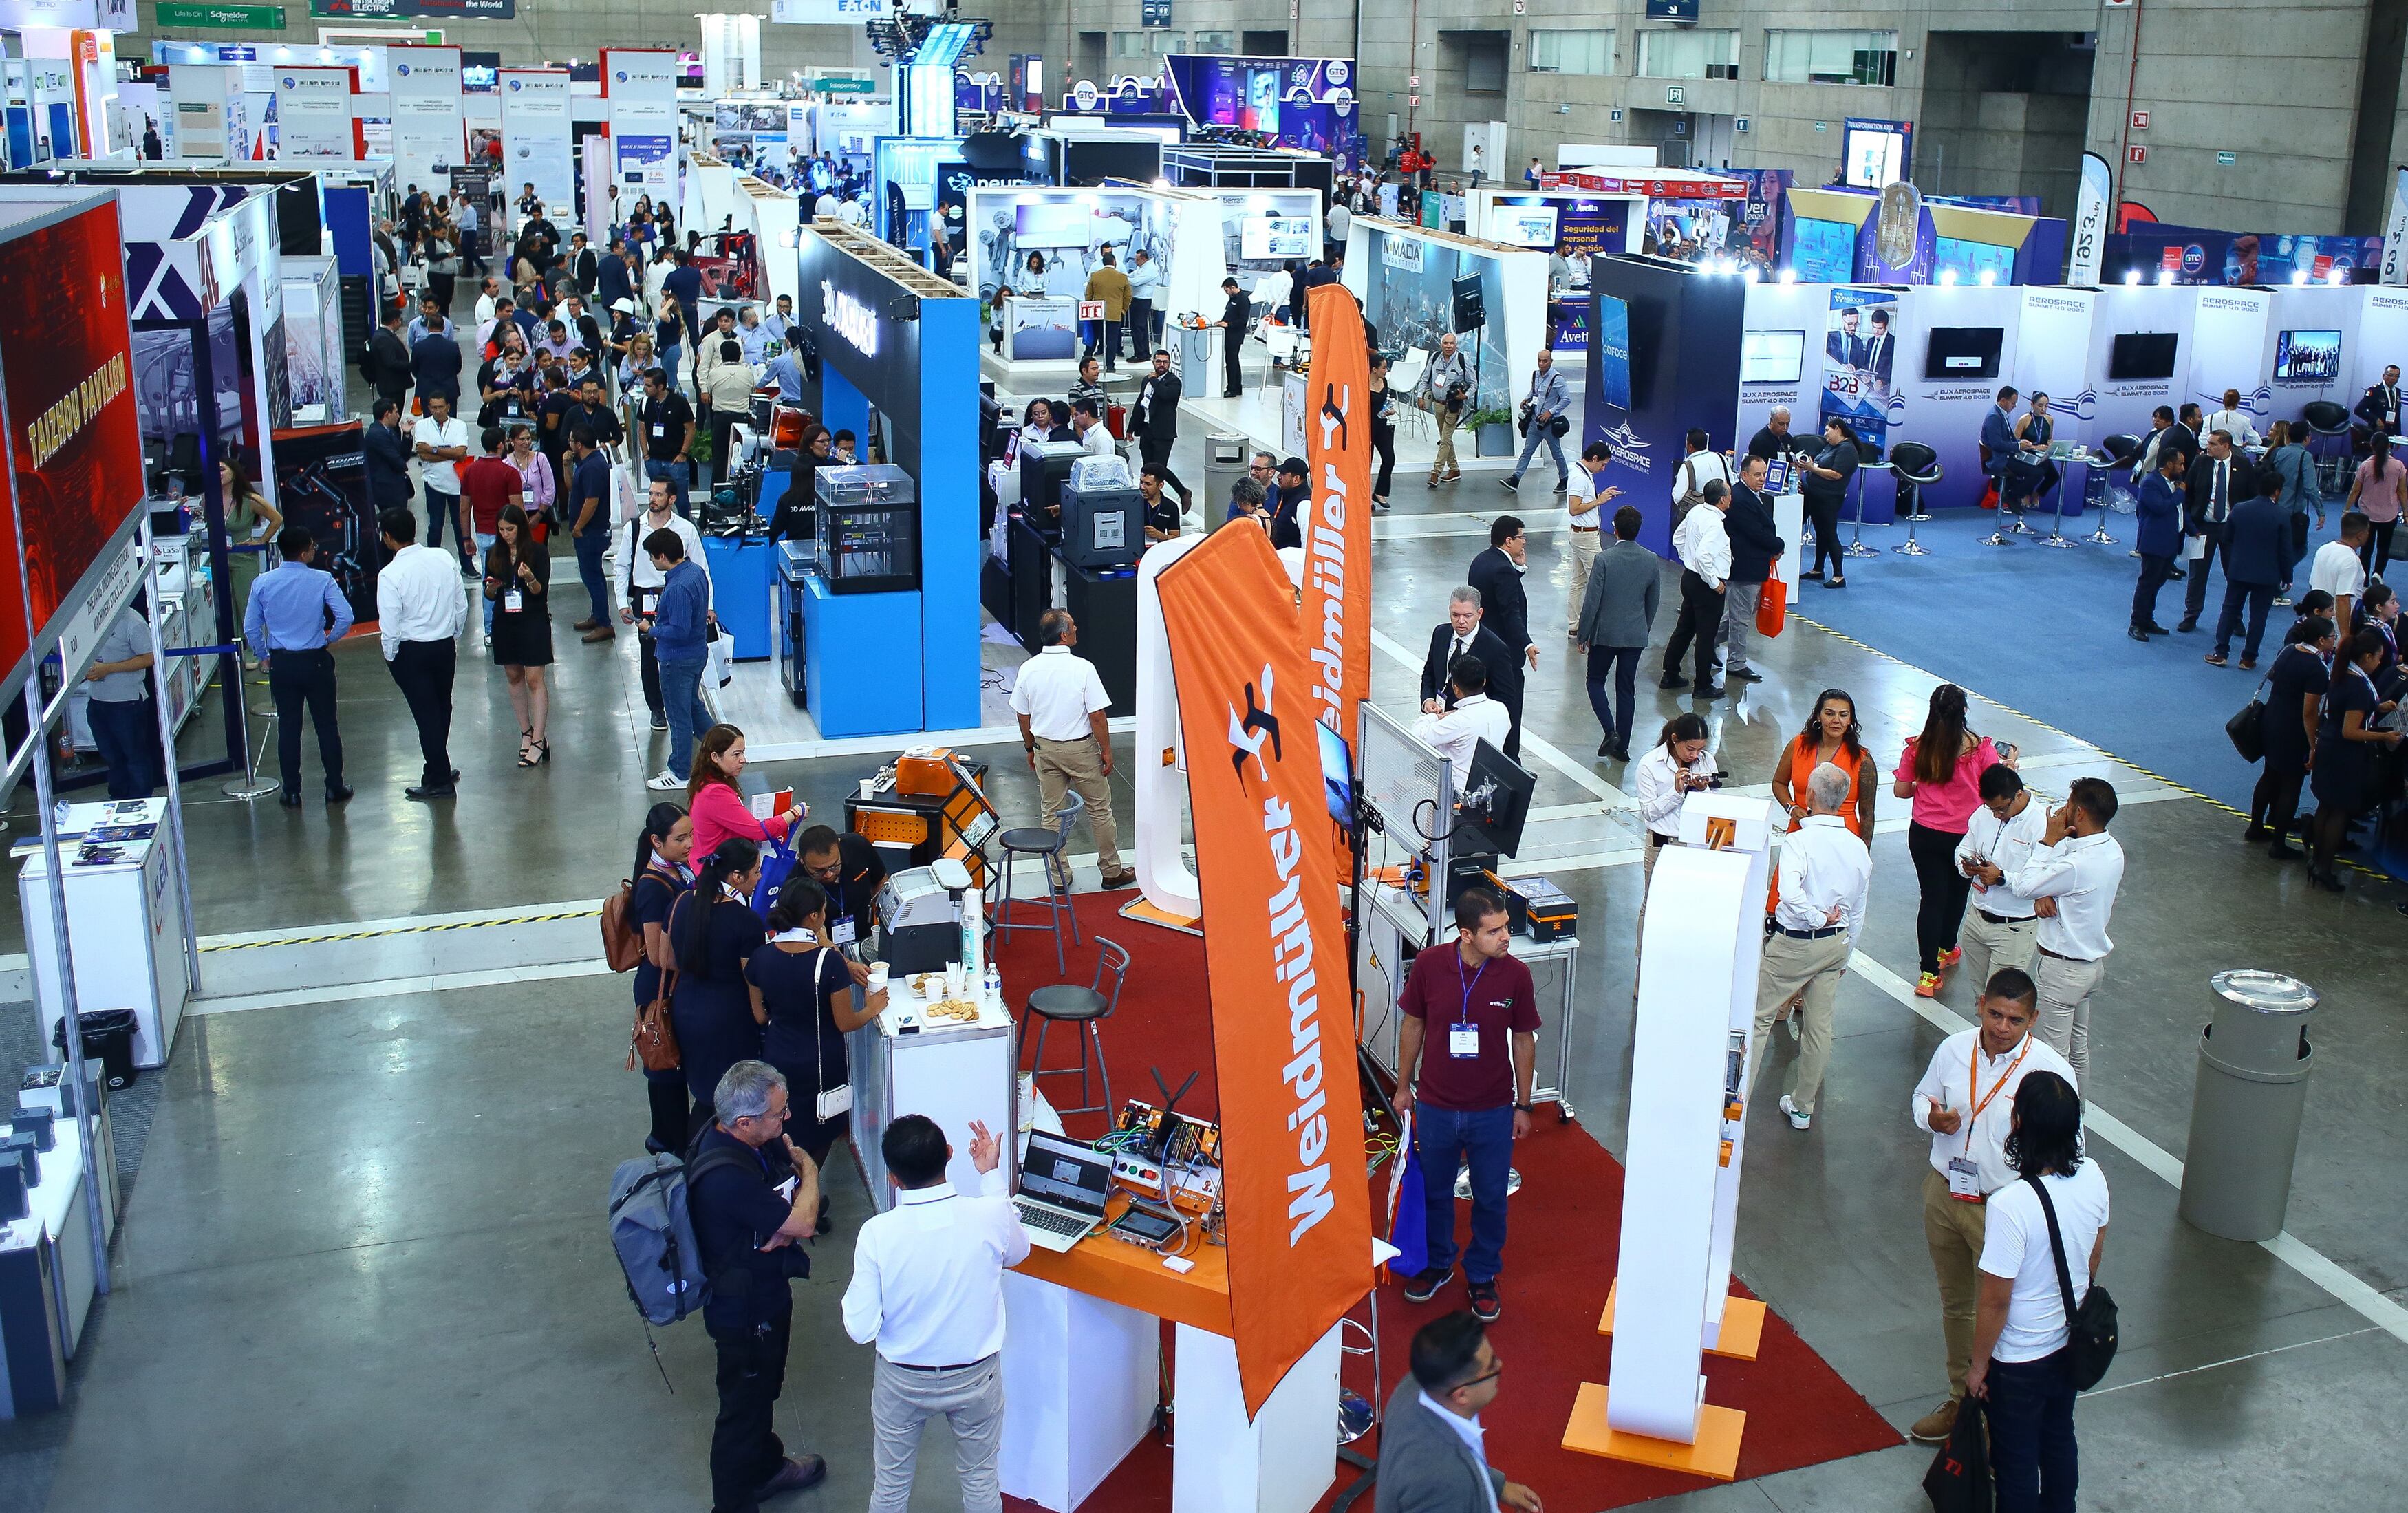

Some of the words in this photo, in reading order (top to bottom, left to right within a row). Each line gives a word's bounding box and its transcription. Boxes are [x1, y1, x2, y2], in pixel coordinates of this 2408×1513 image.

[352, 3, 390, 12] ELECTRIC
[466, 0, 479, 8] the
[480, 0, 503, 9] World
[838, 0, 881, 12] EATON
[210, 10, 249, 22] Schneider
[829, 82, 861, 90] kaspersky
[1078, 90, 1095, 100] GTO
[1576, 203, 1598, 212] Avetta
[1748, 213, 1765, 221] 2023
[1563, 225, 1604, 234] Seguridad
[1606, 225, 1619, 233] del
[2029, 296, 2085, 309] AEROSPACE
[2202, 297, 2259, 308] AEROSPACE
[2372, 297, 2408, 306] AEROSP
[1559, 330, 1589, 343] Avett
[1829, 374, 1859, 394] B2B
[28, 387, 81, 472] TAIZHOU
[80, 351, 127, 425] PAVILION
[1599, 440, 1651, 469] XAEROSPACE
[1311, 462, 1347, 736] eidmüller
[1264, 795, 1335, 1249] Weidmüller
